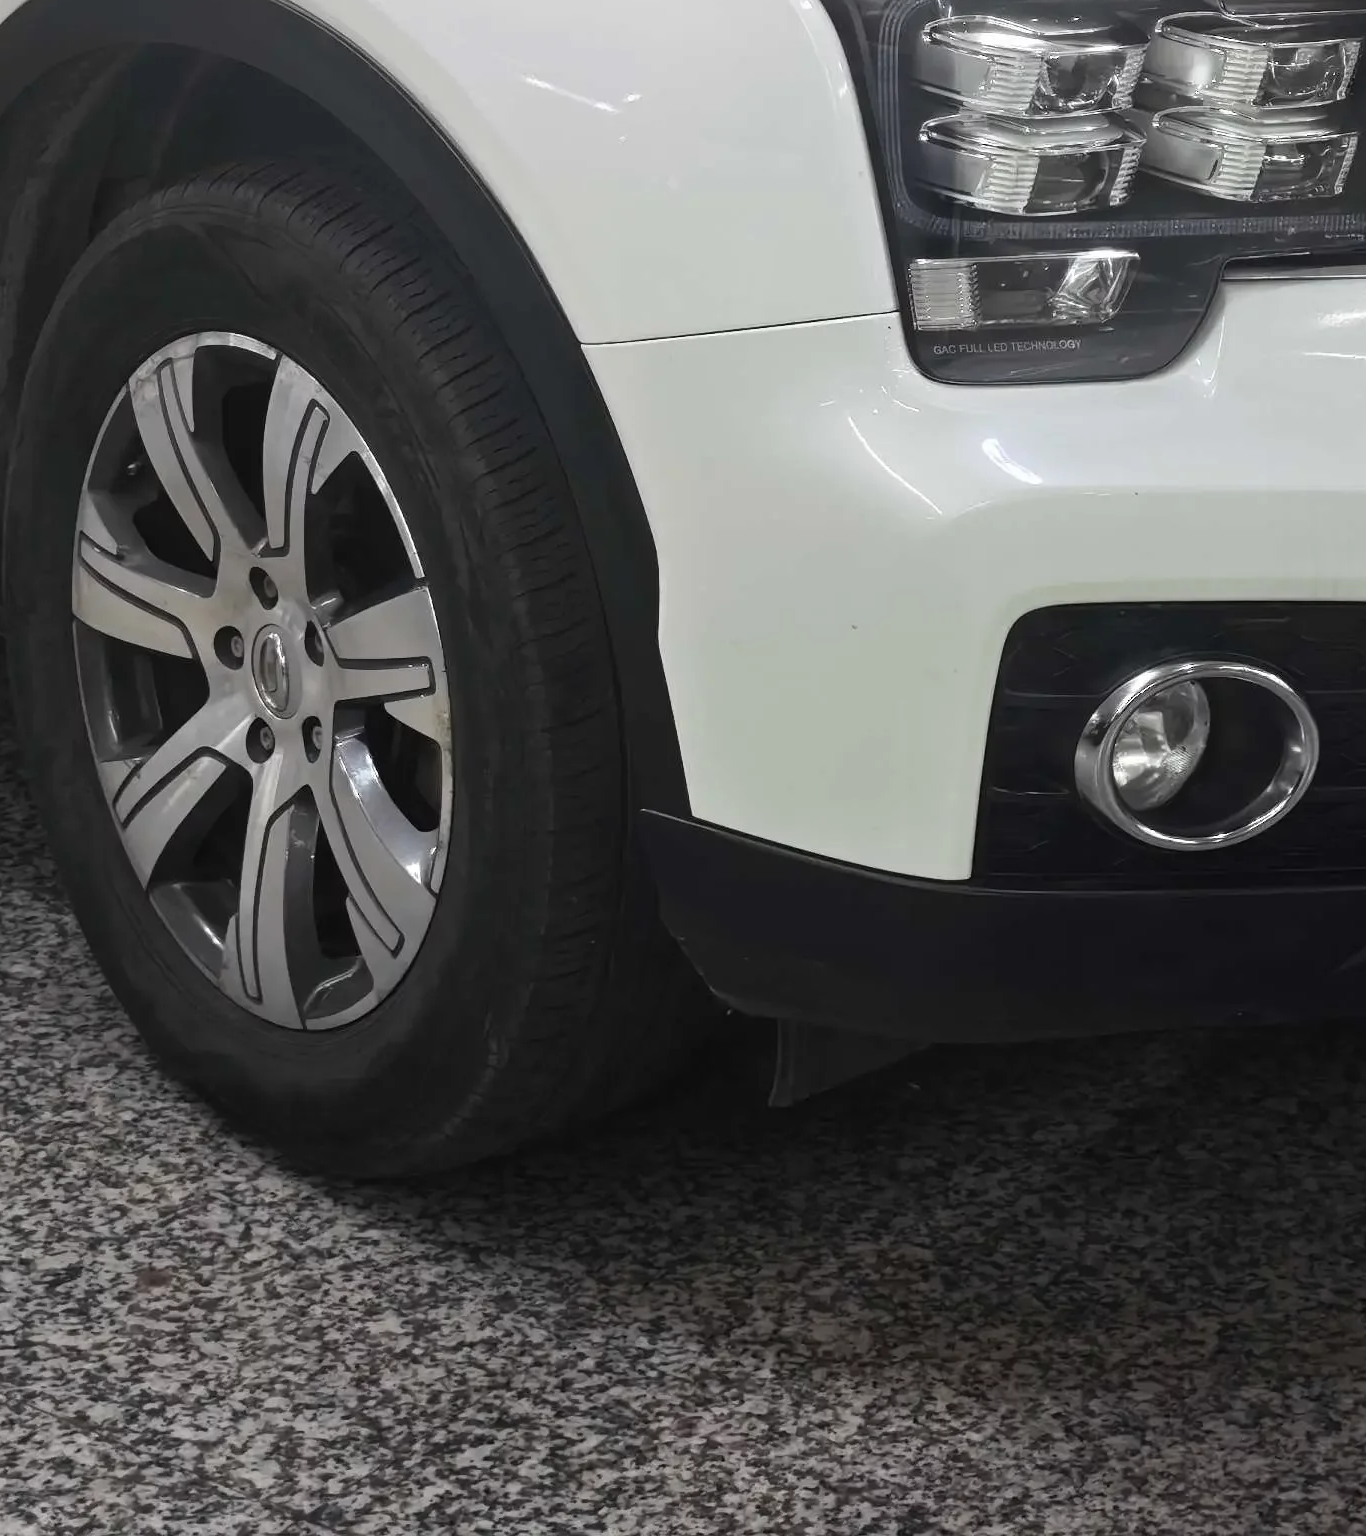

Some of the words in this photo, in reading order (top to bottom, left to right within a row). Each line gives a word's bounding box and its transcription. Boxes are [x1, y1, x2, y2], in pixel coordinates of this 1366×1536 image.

[933, 344, 957, 355] GAC
[959, 343, 984, 353] FULL
[987, 342, 1008, 353] LED
[1010, 339, 1082, 352] TECHNOLOGY
